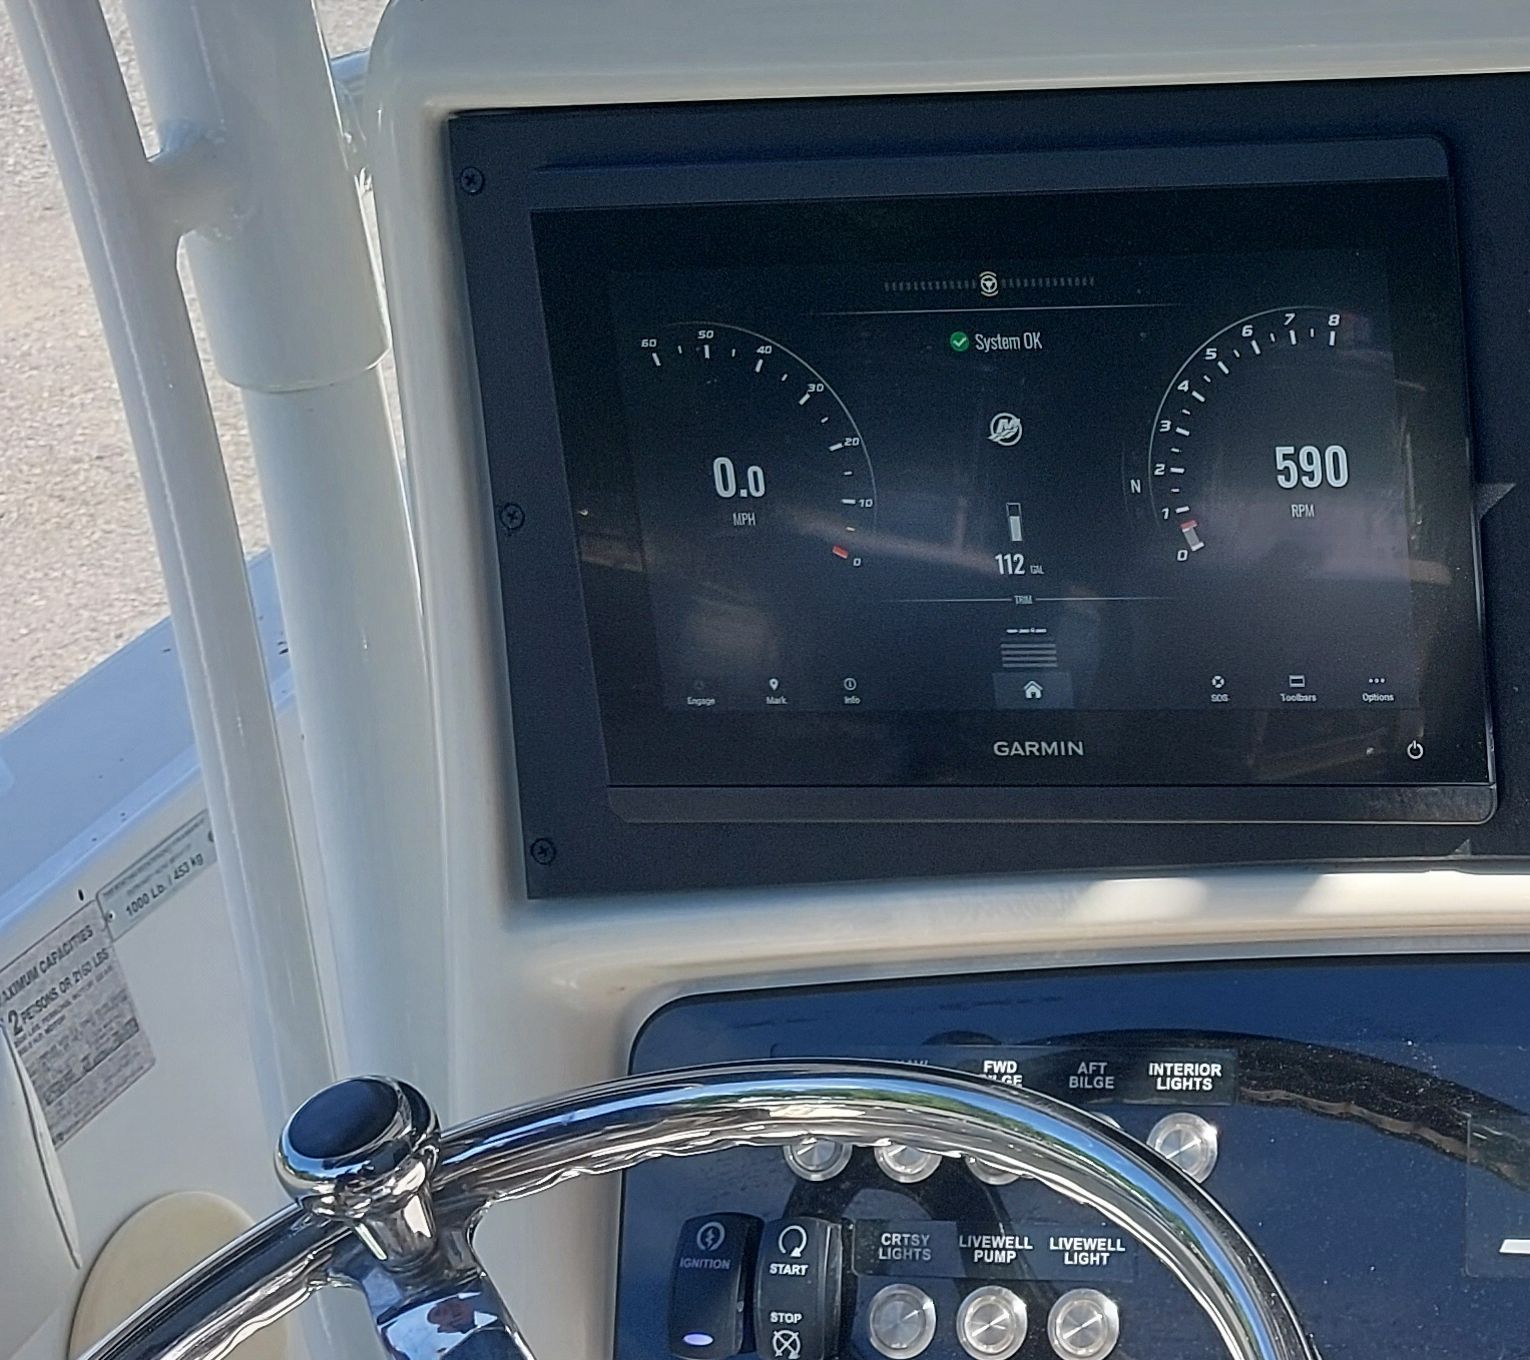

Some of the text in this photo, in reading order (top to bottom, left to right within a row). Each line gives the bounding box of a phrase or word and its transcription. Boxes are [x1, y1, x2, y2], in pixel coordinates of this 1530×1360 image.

[1284, 313, 1295, 325] 7
[1328, 314, 1341, 327] 8
[698, 330, 714, 339] 50
[1242, 325, 1253, 337] 6
[641, 339, 656, 348] 60
[975, 332, 1043, 352] System OK
[756, 345, 772, 355] 40
[1205, 349, 1217, 360] 5
[807, 383, 825, 393] 30
[1177, 380, 1190, 392] 4
[1160, 421, 1171, 432] 3
[843, 437, 860, 446] 20
[1153, 464, 1165, 476] 2
[1274, 445, 1350, 488] 590
[712, 457, 766, 498] 0.0
[1130, 479, 1141, 493] N
[858, 498, 873, 508] 10
[1161, 508, 1170, 519] 1
[1290, 504, 1315, 518] RPM
[732, 512, 756, 526] MPH
[852, 557, 862, 567] 0
[1176, 550, 1188, 561] 0
[995, 553, 1025, 575] 112
[766, 696, 788, 705] Mark
[843, 696, 861, 705] Info
[1362, 693, 1394, 703] Options
[993, 741, 1084, 756] GARMIN
[126, 893, 150, 916] 1000
[0, 965, 39, 1001] AXIMUM
[983, 1060, 1018, 1074] FWD
[1077, 1061, 1107, 1075] AFT
[1148, 1062, 1221, 1078] INTERIOR
[1069, 1075, 1114, 1090] BILGE
[1156, 1077, 1213, 1092] LIGHTS
[881, 1233, 930, 1247] CRTSY
[958, 1236, 1033, 1250] LIVEWELL
[1049, 1237, 1125, 1252] LIVEWELL
[878, 1247, 932, 1262] LIGHTS
[973, 1249, 1017, 1264] PUMP
[1064, 1251, 1110, 1266] LIGHT
[679, 1257, 731, 1271] IGNITION
[769, 1263, 808, 1276] START
[770, 1312, 802, 1325] STOP
